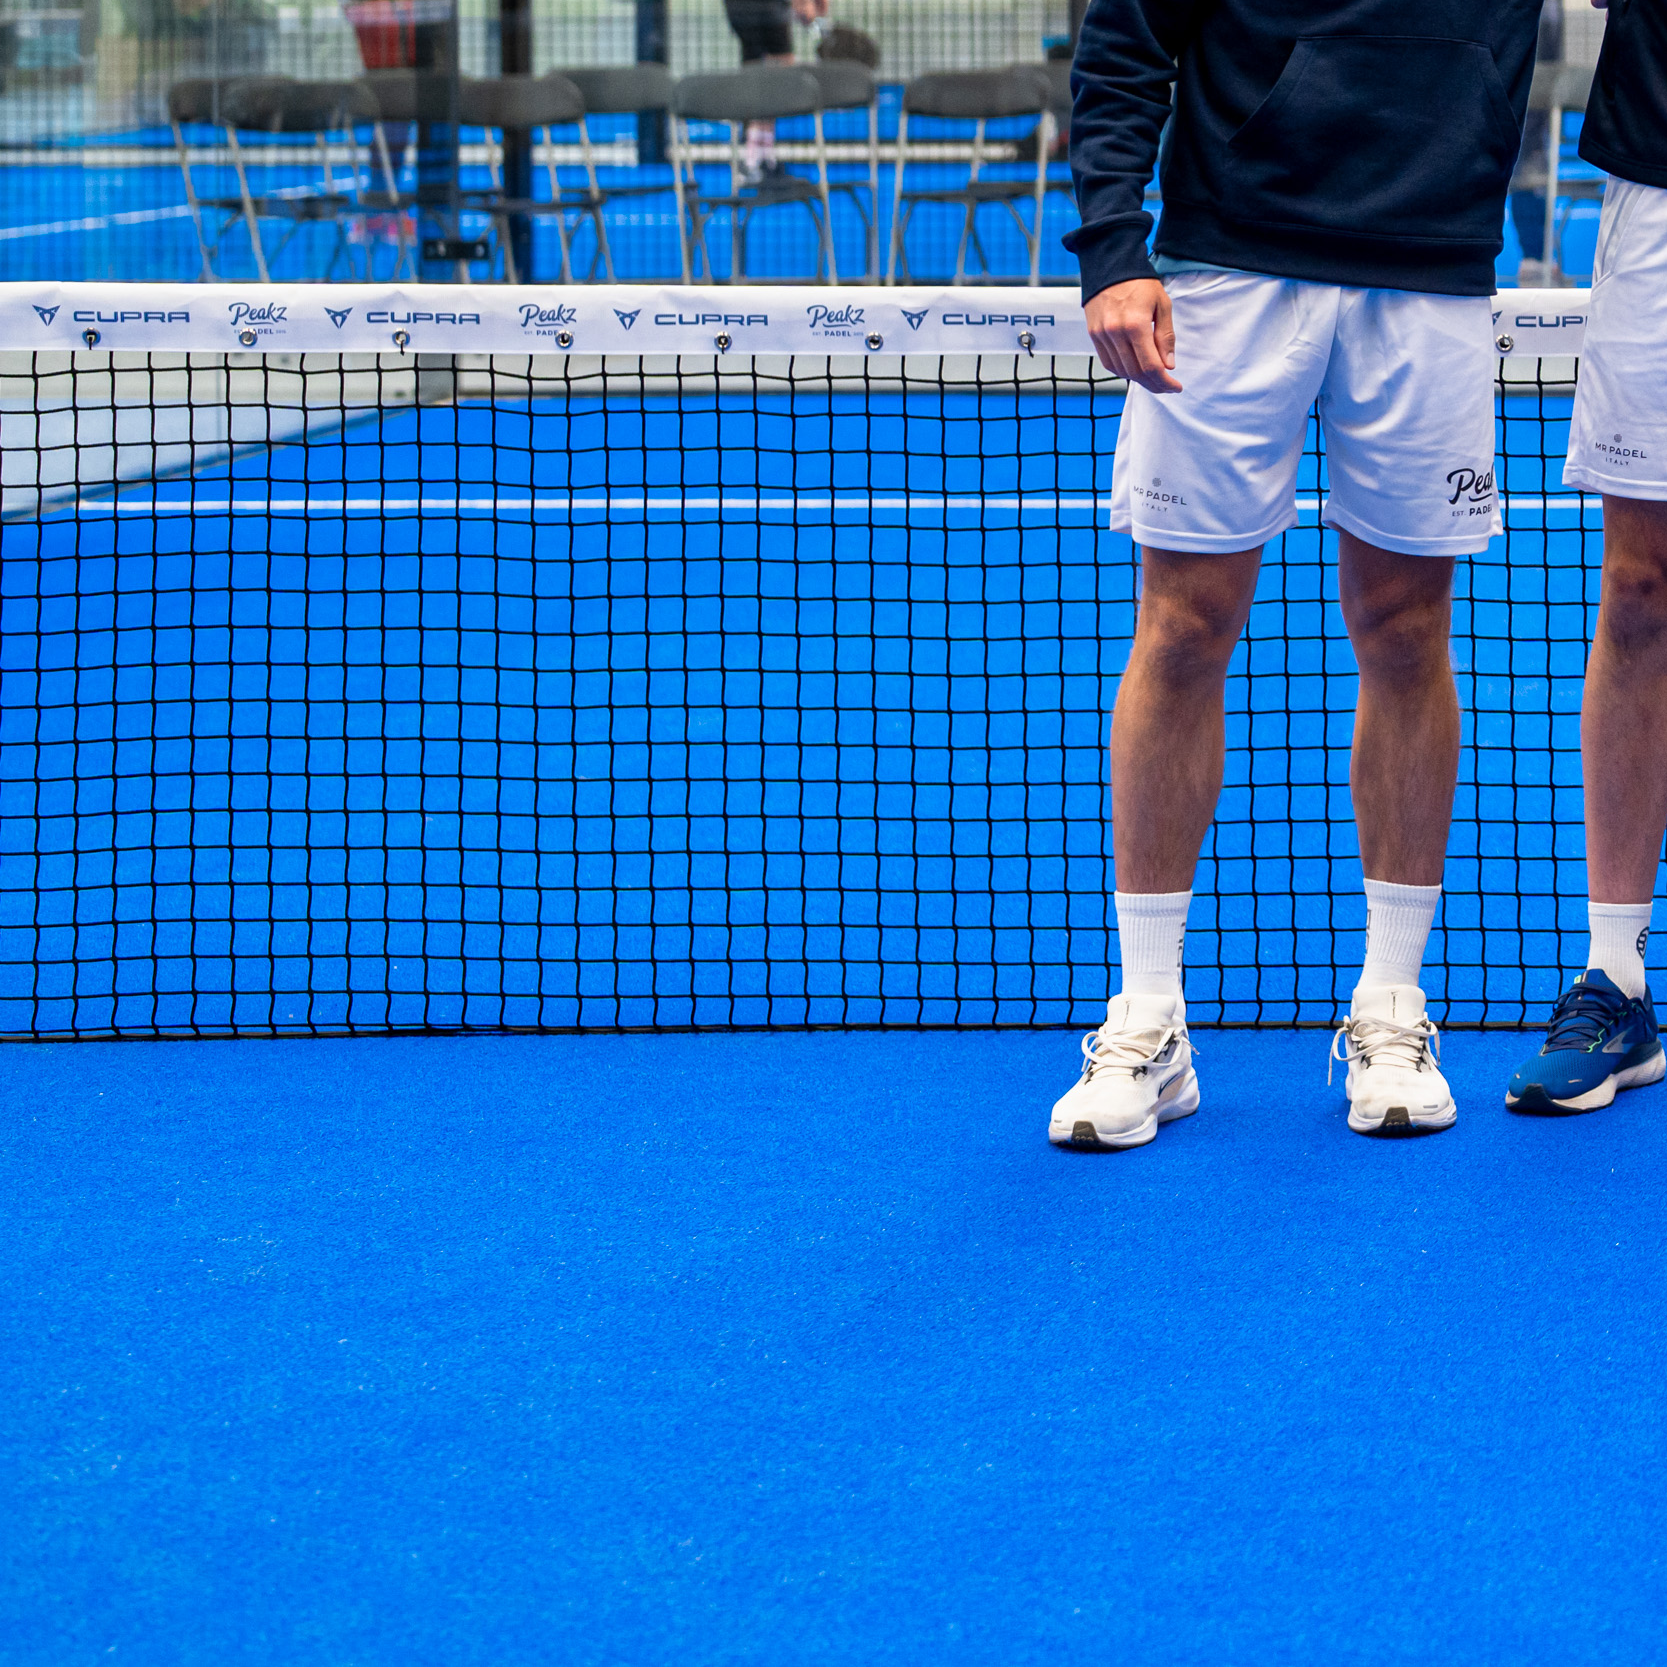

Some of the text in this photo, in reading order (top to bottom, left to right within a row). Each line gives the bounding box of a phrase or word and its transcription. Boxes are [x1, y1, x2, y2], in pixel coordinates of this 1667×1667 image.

[73, 310, 190, 323] CUPRA
[228, 302, 288, 326] Peakz
[366, 311, 481, 325] CUPRA
[518, 303, 577, 328] Peakz
[654, 313, 769, 326] CUPRA
[806, 304, 865, 328] Peakz
[942, 313, 1055, 327] CUPRA
[1515, 315, 1588, 328] CUP
[1609, 445, 1648, 459] PADEL
[1446, 462, 1494, 505] Pea
[1146, 490, 1188, 506] PADEL
[1469, 503, 1493, 517] PADE
